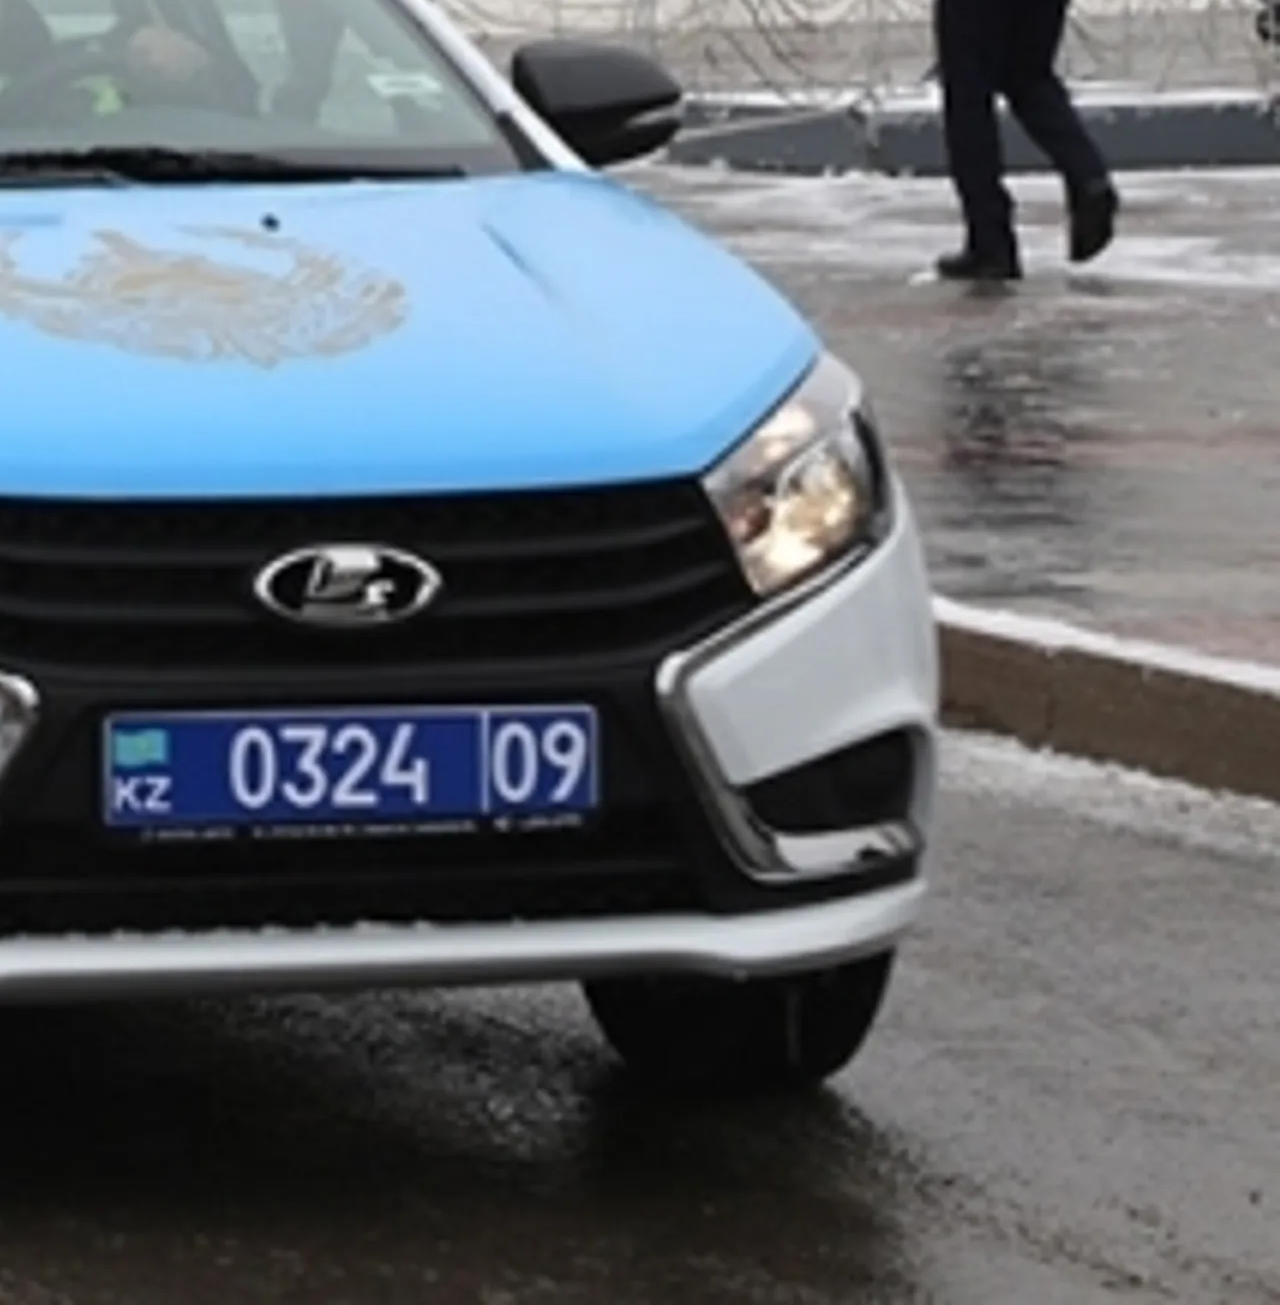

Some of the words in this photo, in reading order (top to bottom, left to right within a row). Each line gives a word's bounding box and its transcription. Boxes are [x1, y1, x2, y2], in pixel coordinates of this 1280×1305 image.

[112, 776, 171, 812] KZ
[229, 724, 428, 808] 0324
[492, 722, 587, 803] 09
